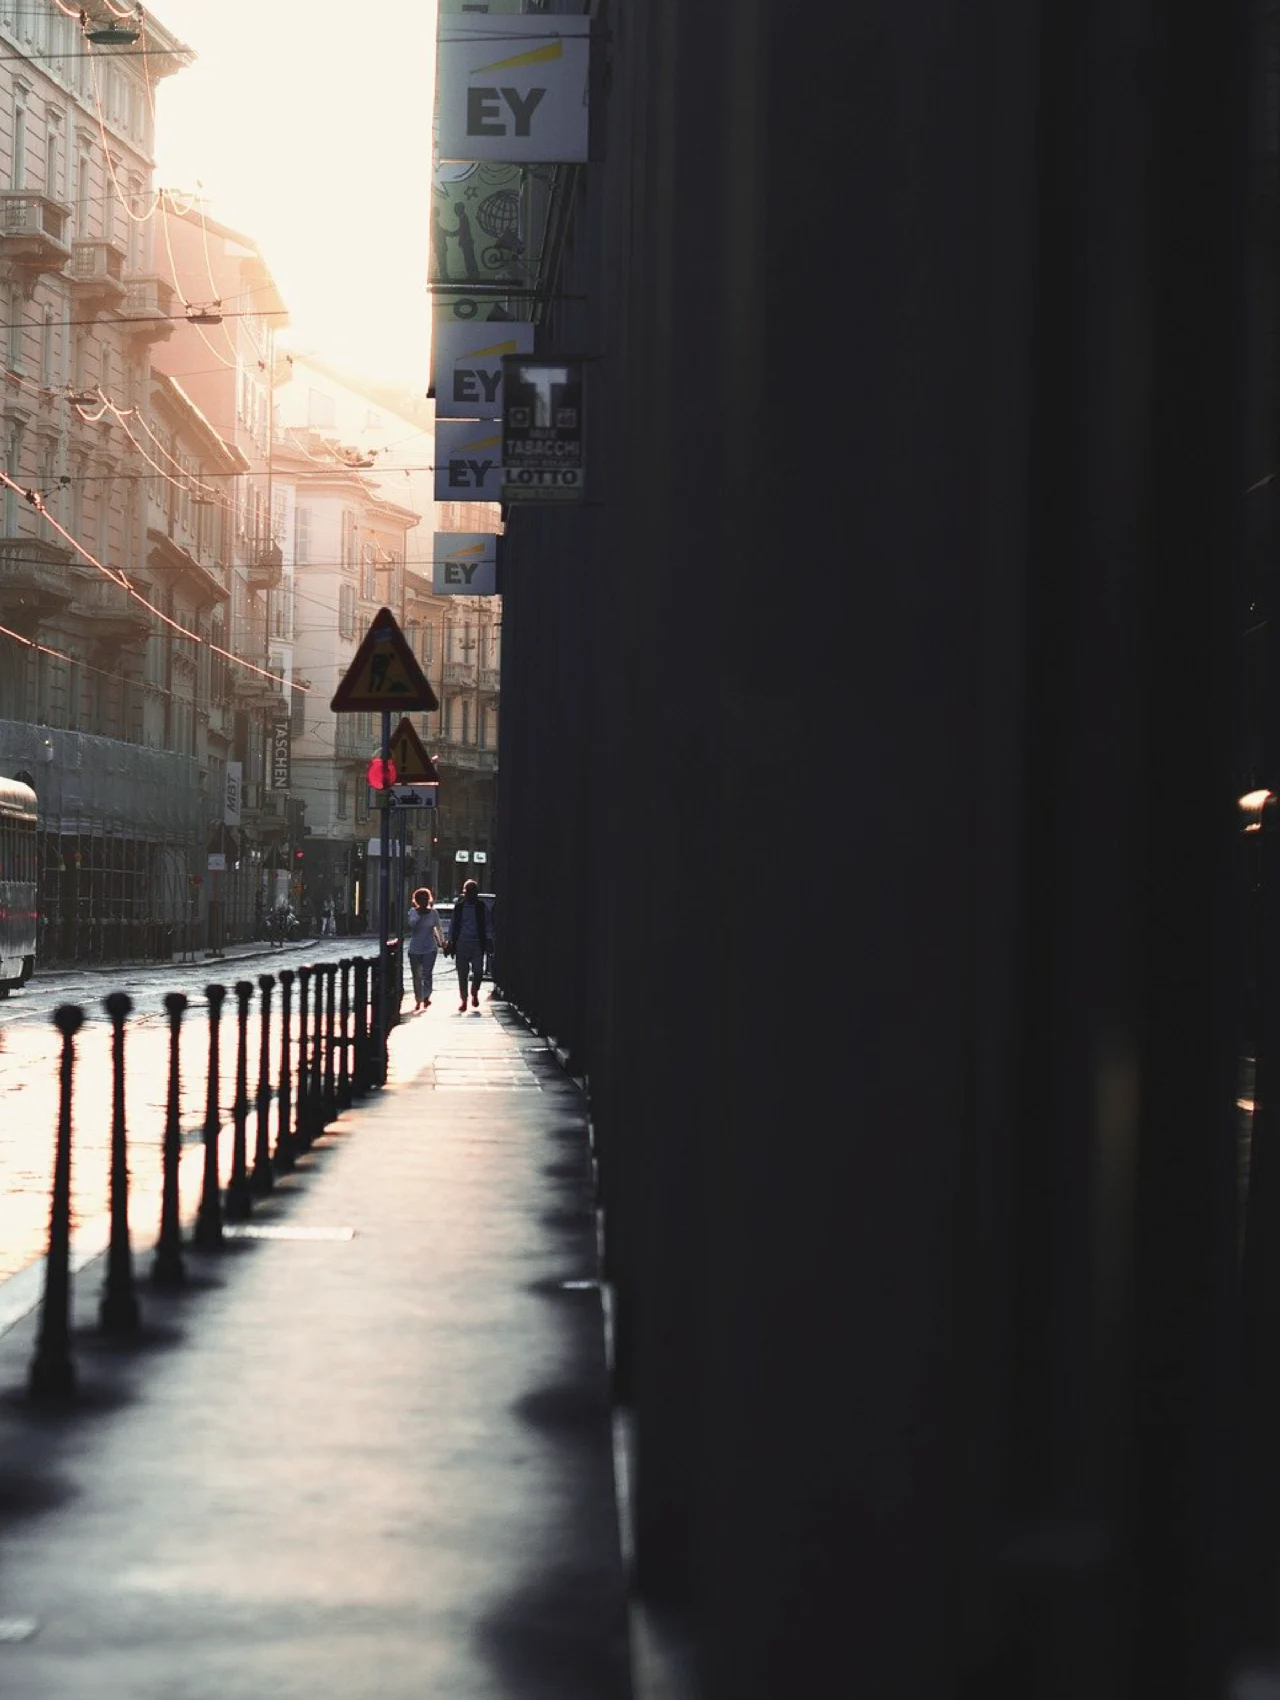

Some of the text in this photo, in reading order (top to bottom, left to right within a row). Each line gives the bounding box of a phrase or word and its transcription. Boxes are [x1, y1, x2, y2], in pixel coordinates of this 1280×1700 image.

[466, 87, 547, 137] EY
[453, 369, 502, 403] EY
[519, 367, 569, 428] T
[506, 439, 580, 457] TABACCHI
[448, 459, 493, 488] EY
[506, 469, 577, 485] LOTTO
[444, 562, 478, 585] EY
[274, 722, 288, 789] TASCHEN
[226, 773, 238, 814] MBT
